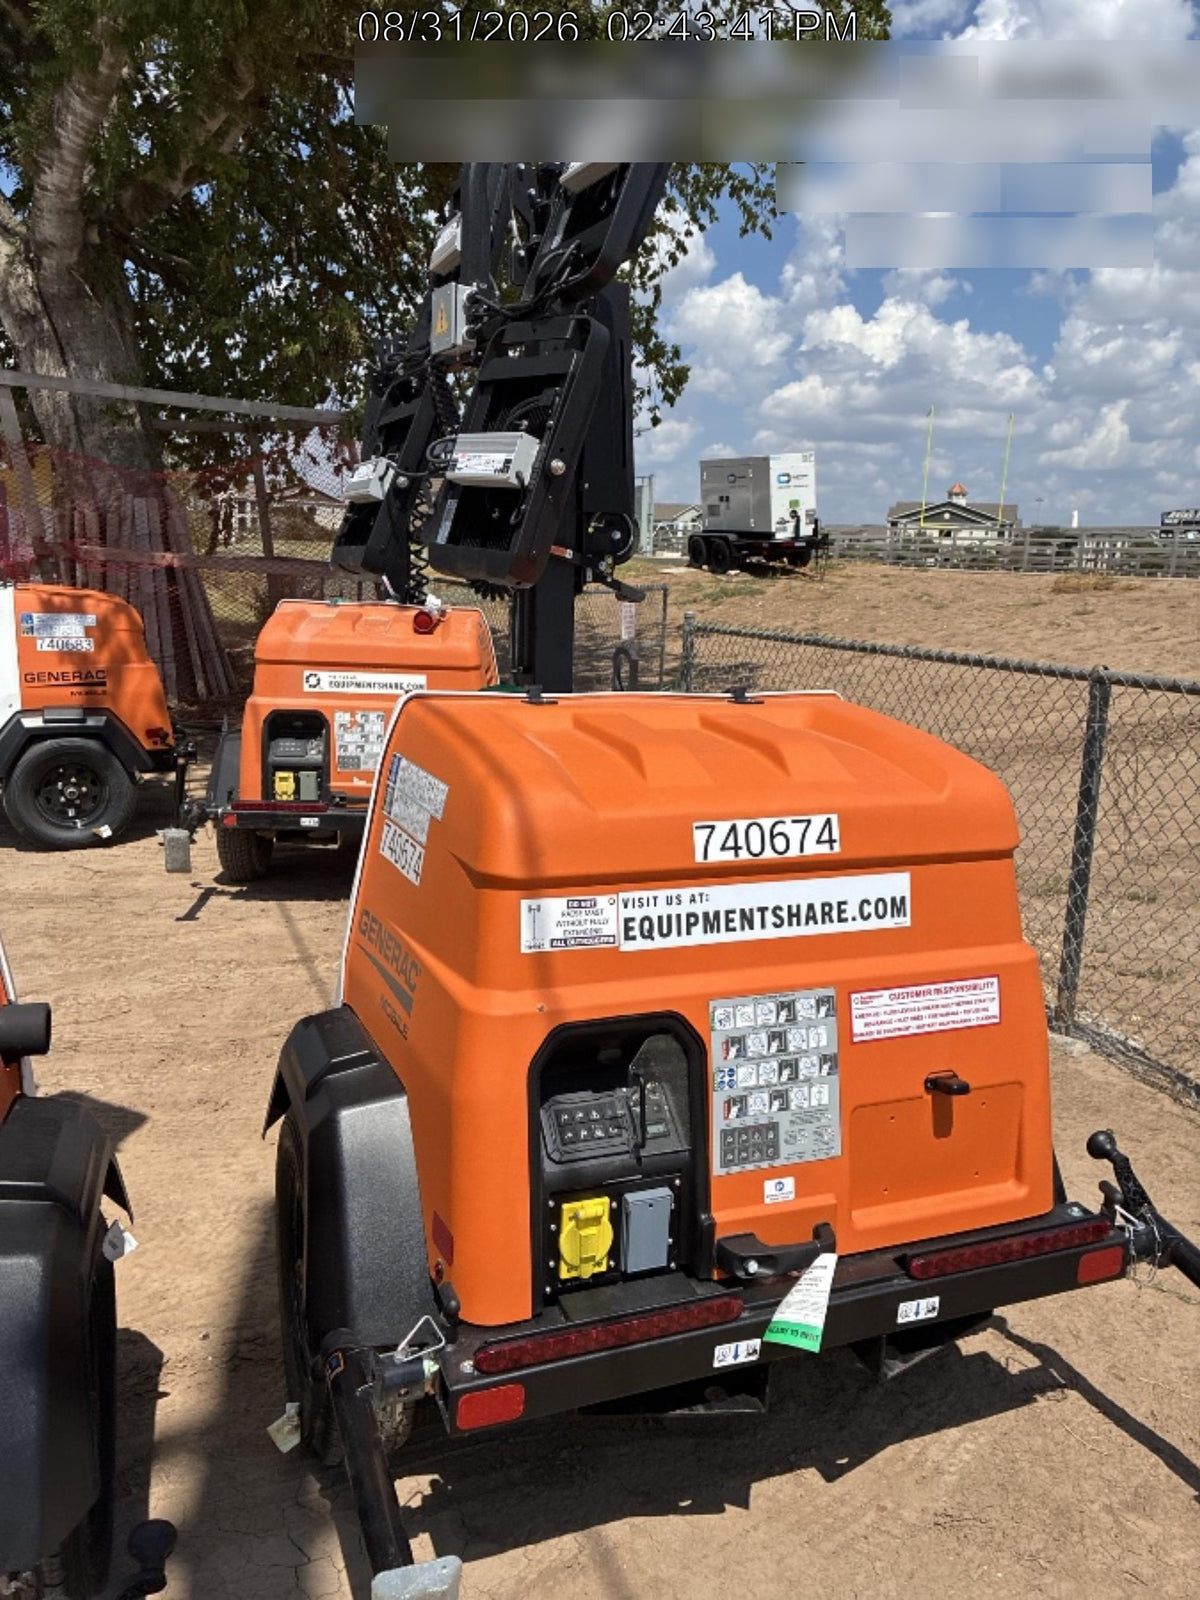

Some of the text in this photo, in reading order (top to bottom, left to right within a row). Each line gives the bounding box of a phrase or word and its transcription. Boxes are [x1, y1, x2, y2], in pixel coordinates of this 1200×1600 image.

[38, 639, 92, 651] 740683
[24, 670, 107, 683] GENERAC
[695, 817, 838, 861] 740674
[622, 892, 710, 909] VISIT US AT:
[623, 896, 908, 942] EQUIPMENTSHARE.COM
[359, 909, 421, 992] GENERAC
[888, 986, 933, 1001] CUSTOMER
[933, 981, 995, 996] RESPONSIBILITY
